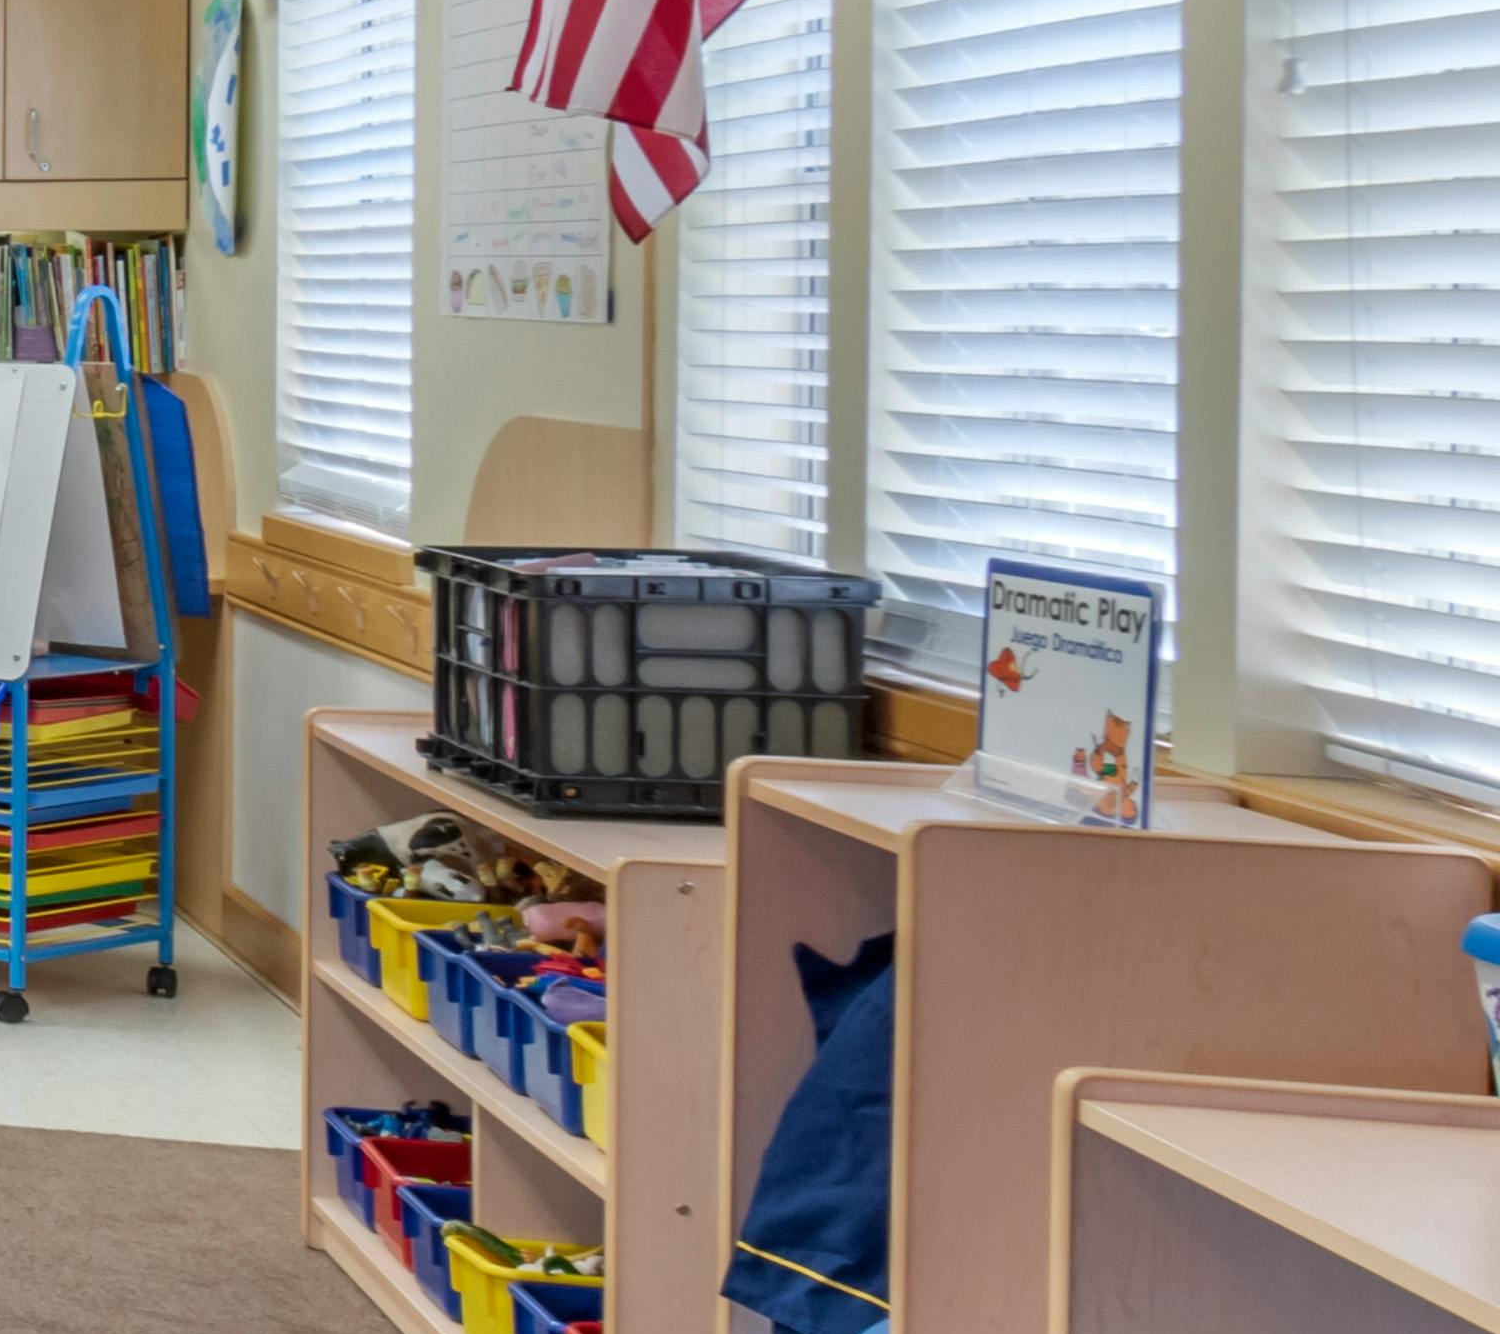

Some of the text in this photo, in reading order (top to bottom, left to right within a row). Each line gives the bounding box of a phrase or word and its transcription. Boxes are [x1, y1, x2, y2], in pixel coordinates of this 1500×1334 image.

[992, 580, 1147, 643] Dramatic Play
[1010, 626, 1048, 652] Juego
